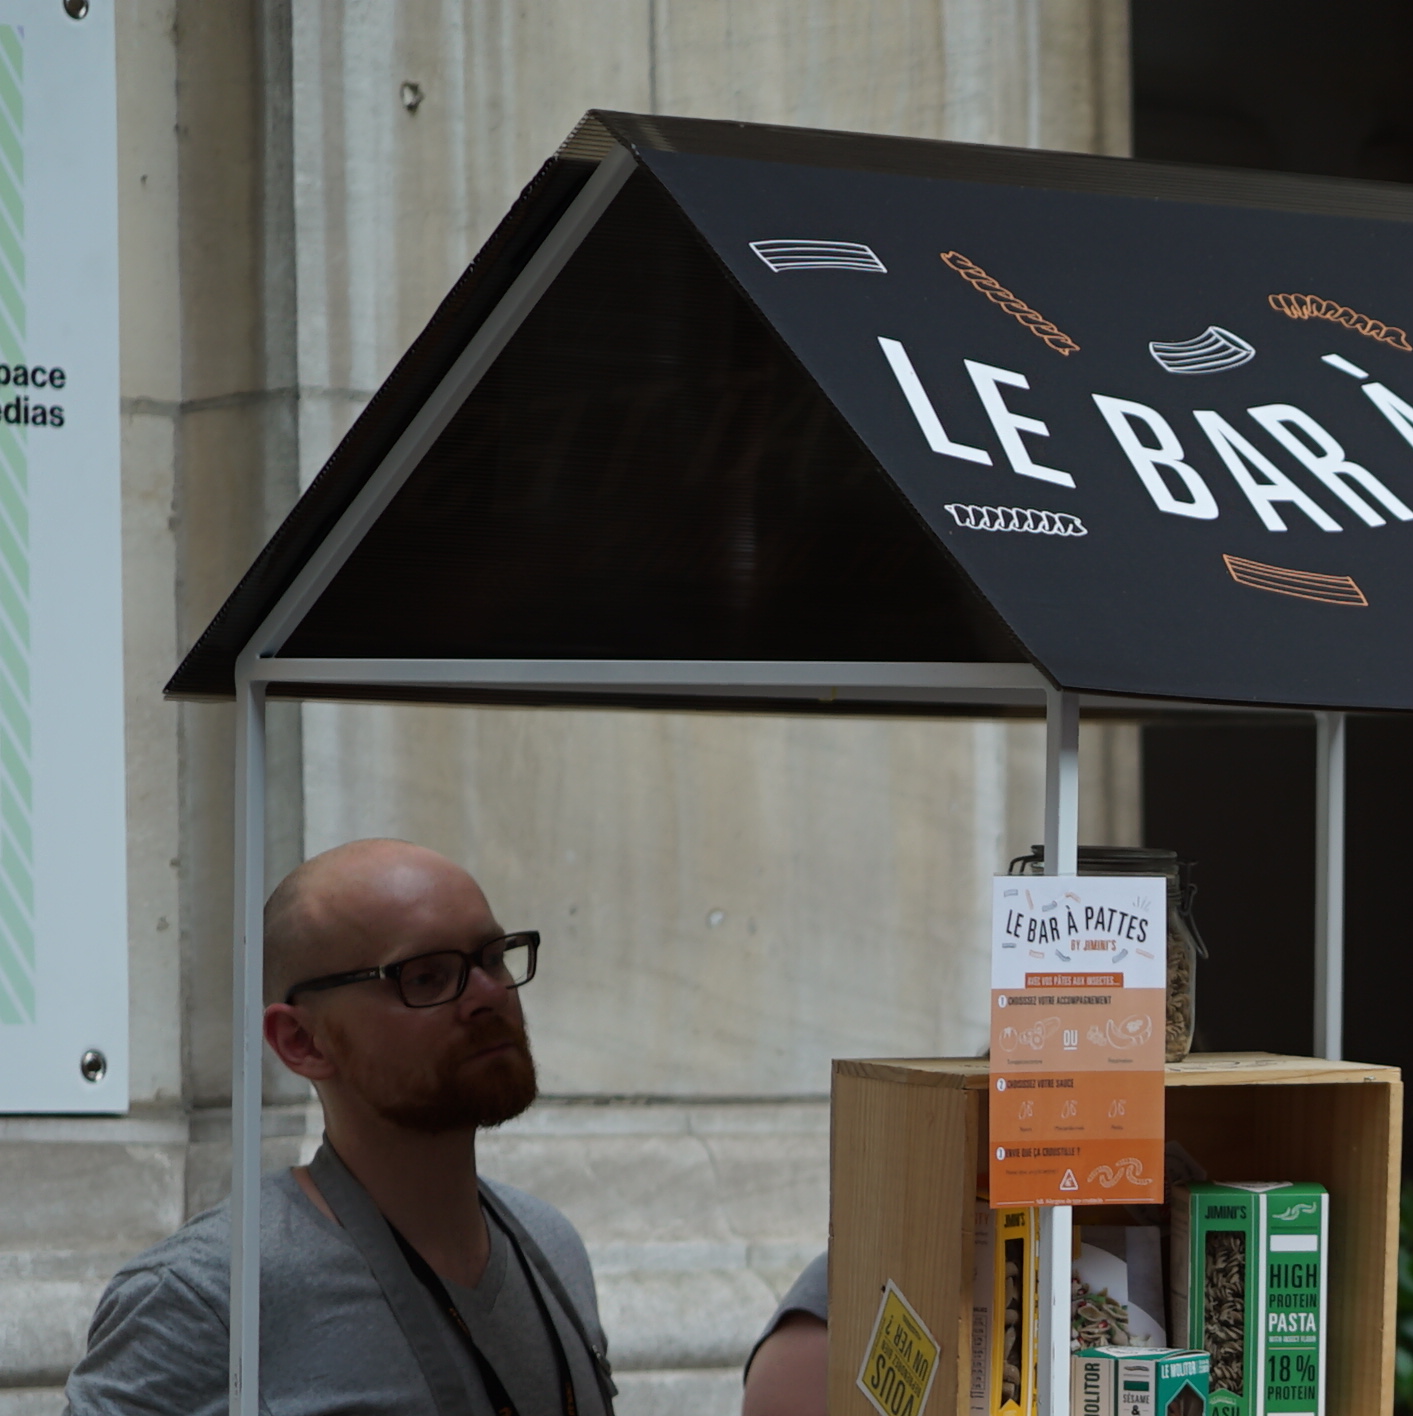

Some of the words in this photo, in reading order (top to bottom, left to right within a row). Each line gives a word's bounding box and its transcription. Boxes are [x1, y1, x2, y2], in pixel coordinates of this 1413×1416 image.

[0, 395, 65, 427] dias
[878, 337, 1076, 489] LE
[1006, 909, 1024, 938] LE
[1027, 917, 1060, 944] BAR
[1065, 905, 1078, 935] À
[1085, 906, 1148, 943] PATTES
[1071, 940, 1080, 950] BY
[1064, 1030, 1078, 1045] OU
[1270, 1264, 1317, 1288] HIGH
[1269, 1294, 1317, 1308] PROTEIN
[1268, 1313, 1316, 1332] PASTA
[894, 1324, 913, 1362] VER
[913, 1349, 929, 1382] UN
[1161, 1365, 1169, 1379] LE
[1170, 1361, 1196, 1377] MOLITOR
[1123, 1393, 1149, 1404] SÉSAME
[1268, 1386, 1315, 1400] PROTEIN
[1131, 1405, 1140, 1416] &
